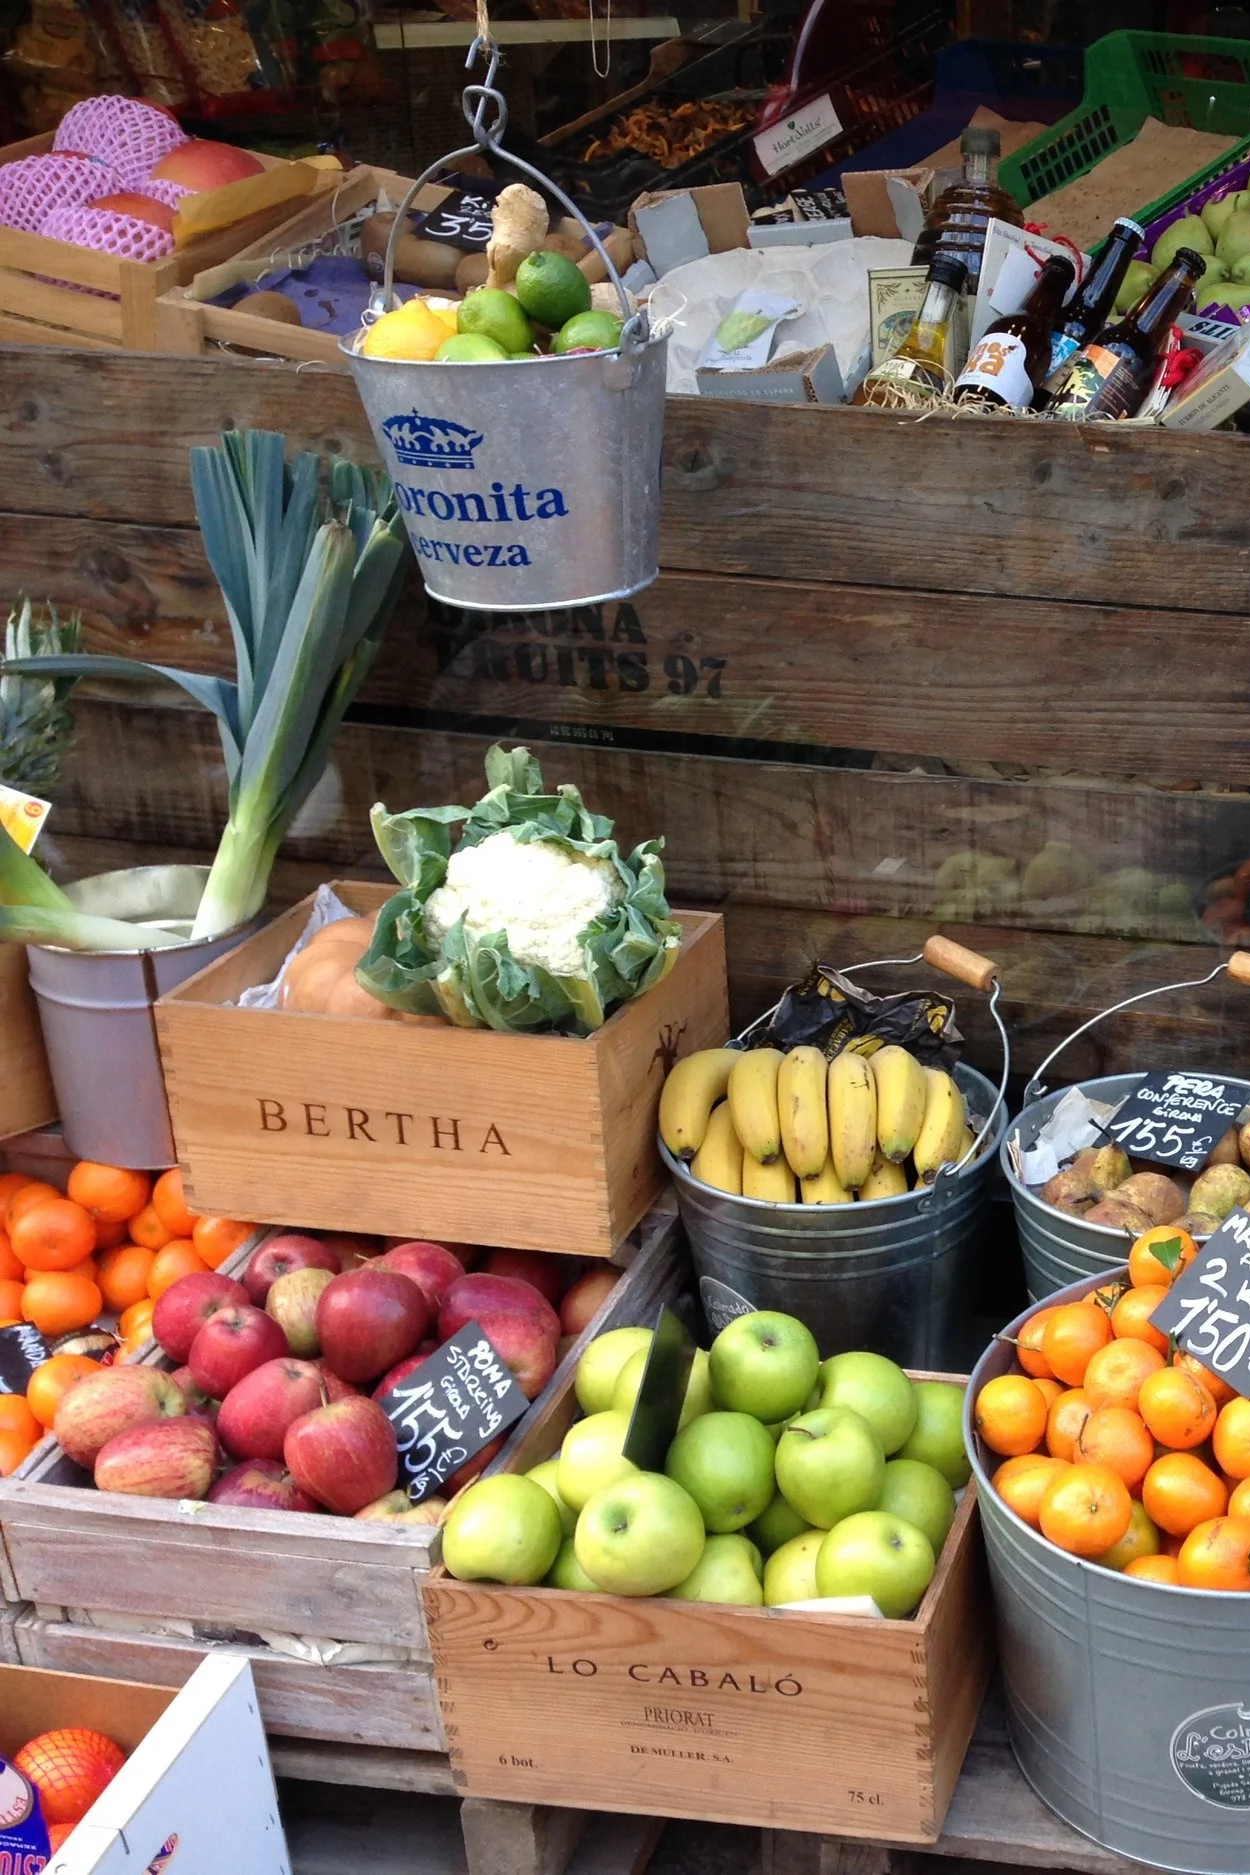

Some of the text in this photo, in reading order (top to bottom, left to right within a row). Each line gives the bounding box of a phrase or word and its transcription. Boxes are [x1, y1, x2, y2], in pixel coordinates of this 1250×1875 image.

[664, 654, 726, 698] 97
[1162, 1075, 1225, 1099] PERA
[1137, 1088, 1241, 1116] CONFERENCE
[256, 1098, 512, 1155] BERTHA
[1199, 1257, 1228, 1298] 2
[468, 1340, 512, 1399] POMA
[547, 1657, 803, 1697] LO CABALÓ
[644, 1706, 715, 1728] PRIORAT
[499, 1754, 538, 1769] 6 bot.
[630, 1745, 648, 1755] DE
[848, 1790, 864, 1804] 75
